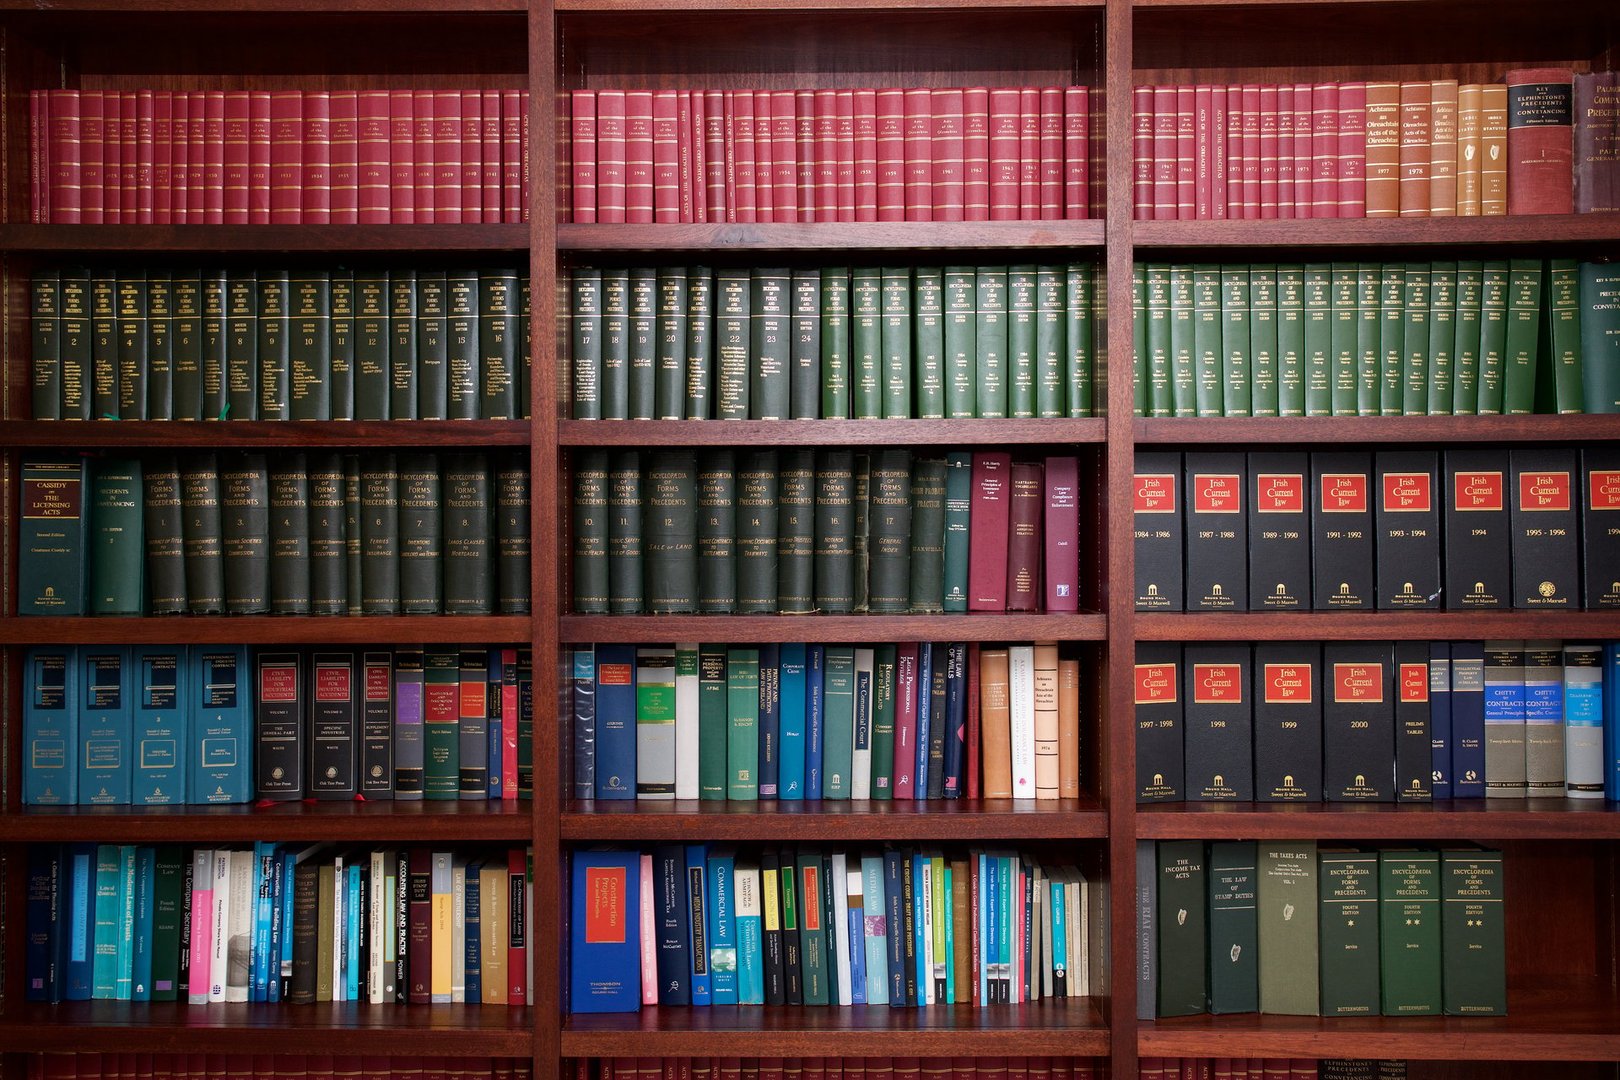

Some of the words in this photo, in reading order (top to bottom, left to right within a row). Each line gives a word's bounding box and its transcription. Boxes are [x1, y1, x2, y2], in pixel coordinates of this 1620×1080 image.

[1210, 480, 1225, 488] Irish
[1399, 478, 1414, 486] Irish
[1536, 477, 1553, 485] Irish
[1204, 489, 1230, 497] Current
[1393, 488, 1420, 496] Current
[1530, 487, 1559, 495] Current
[1212, 499, 1223, 507] Law
[1401, 497, 1413, 505] Law
[1539, 496, 1552, 504] Law
[949, 648, 954, 658] OF
[1210, 669, 1226, 677] Irish
[1281, 669, 1296, 677] Irish
[1204, 679, 1231, 687] Current
[1274, 679, 1302, 687] Current
[1212, 688, 1224, 696] Law
[1282, 688, 1294, 696] Law
[181, 878, 192, 910] Company
[610, 877, 618, 926] Construction
[693, 896, 702, 910] MEDIA
[272, 908, 280, 930] Building
[693, 912, 703, 934] INDUSTRY
[182, 912, 192, 944] Secretary
[695, 936, 703, 971] TRANSACTIONS
[1142, 932, 1150, 981] CONTRACTS
